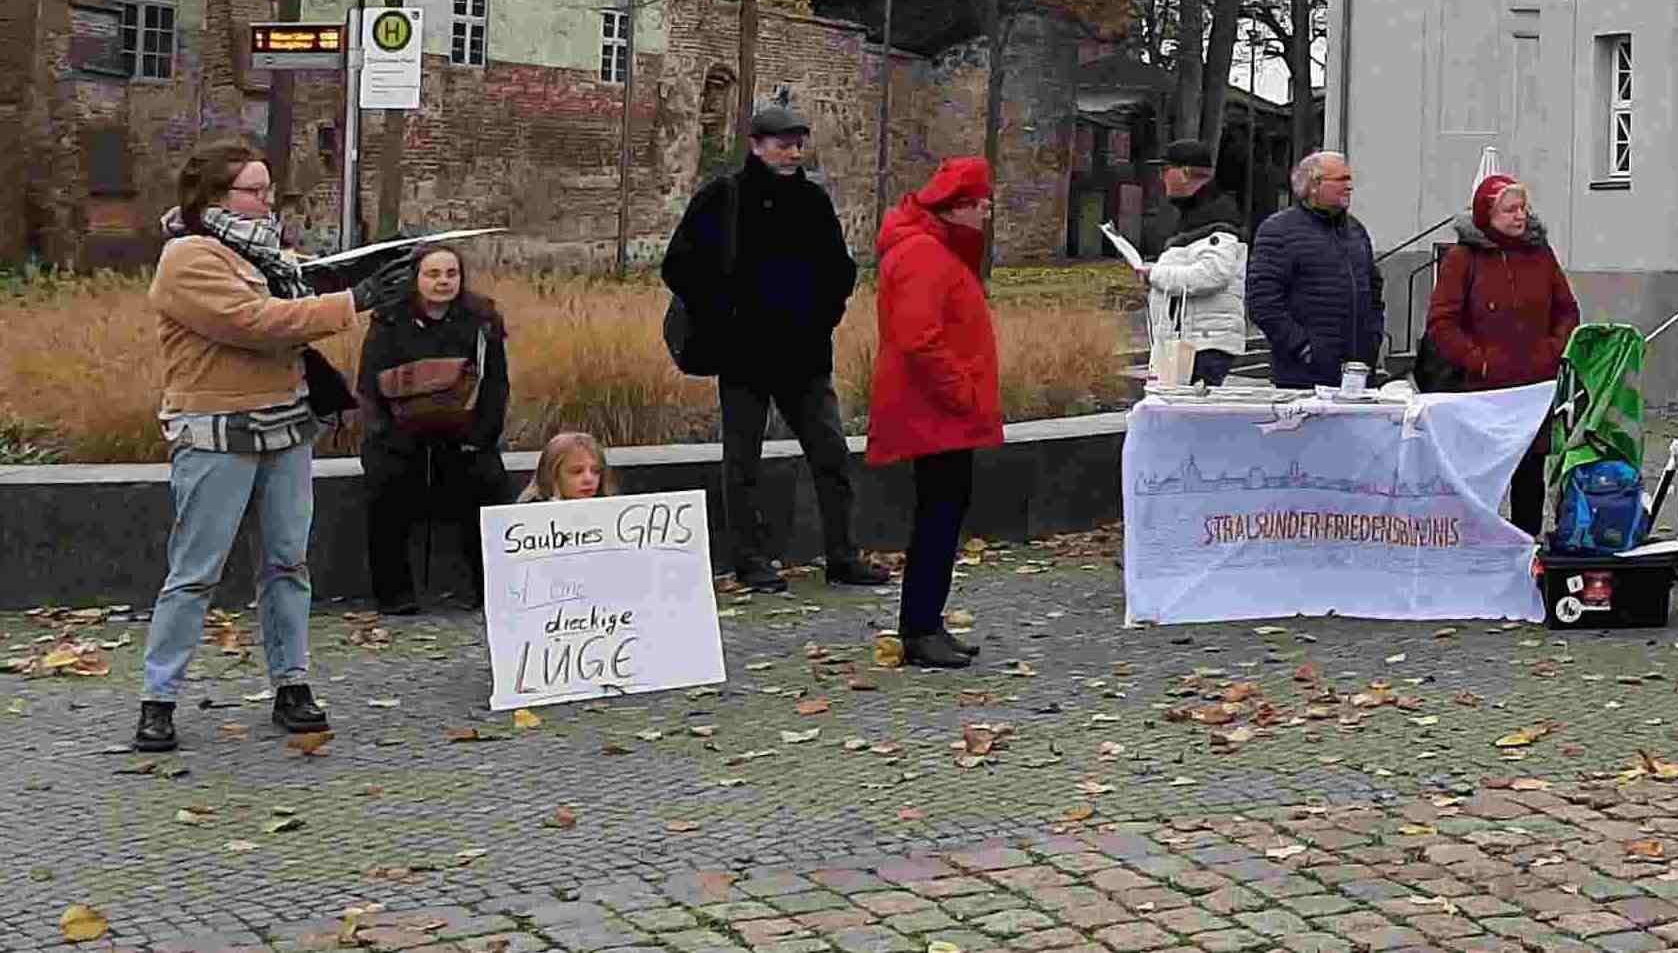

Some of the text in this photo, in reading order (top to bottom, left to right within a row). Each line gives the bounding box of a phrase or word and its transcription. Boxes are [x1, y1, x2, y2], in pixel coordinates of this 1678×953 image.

[504, 503, 693, 554] Sauberes GAS
[1203, 511, 1321, 545] STRALSUNDER
